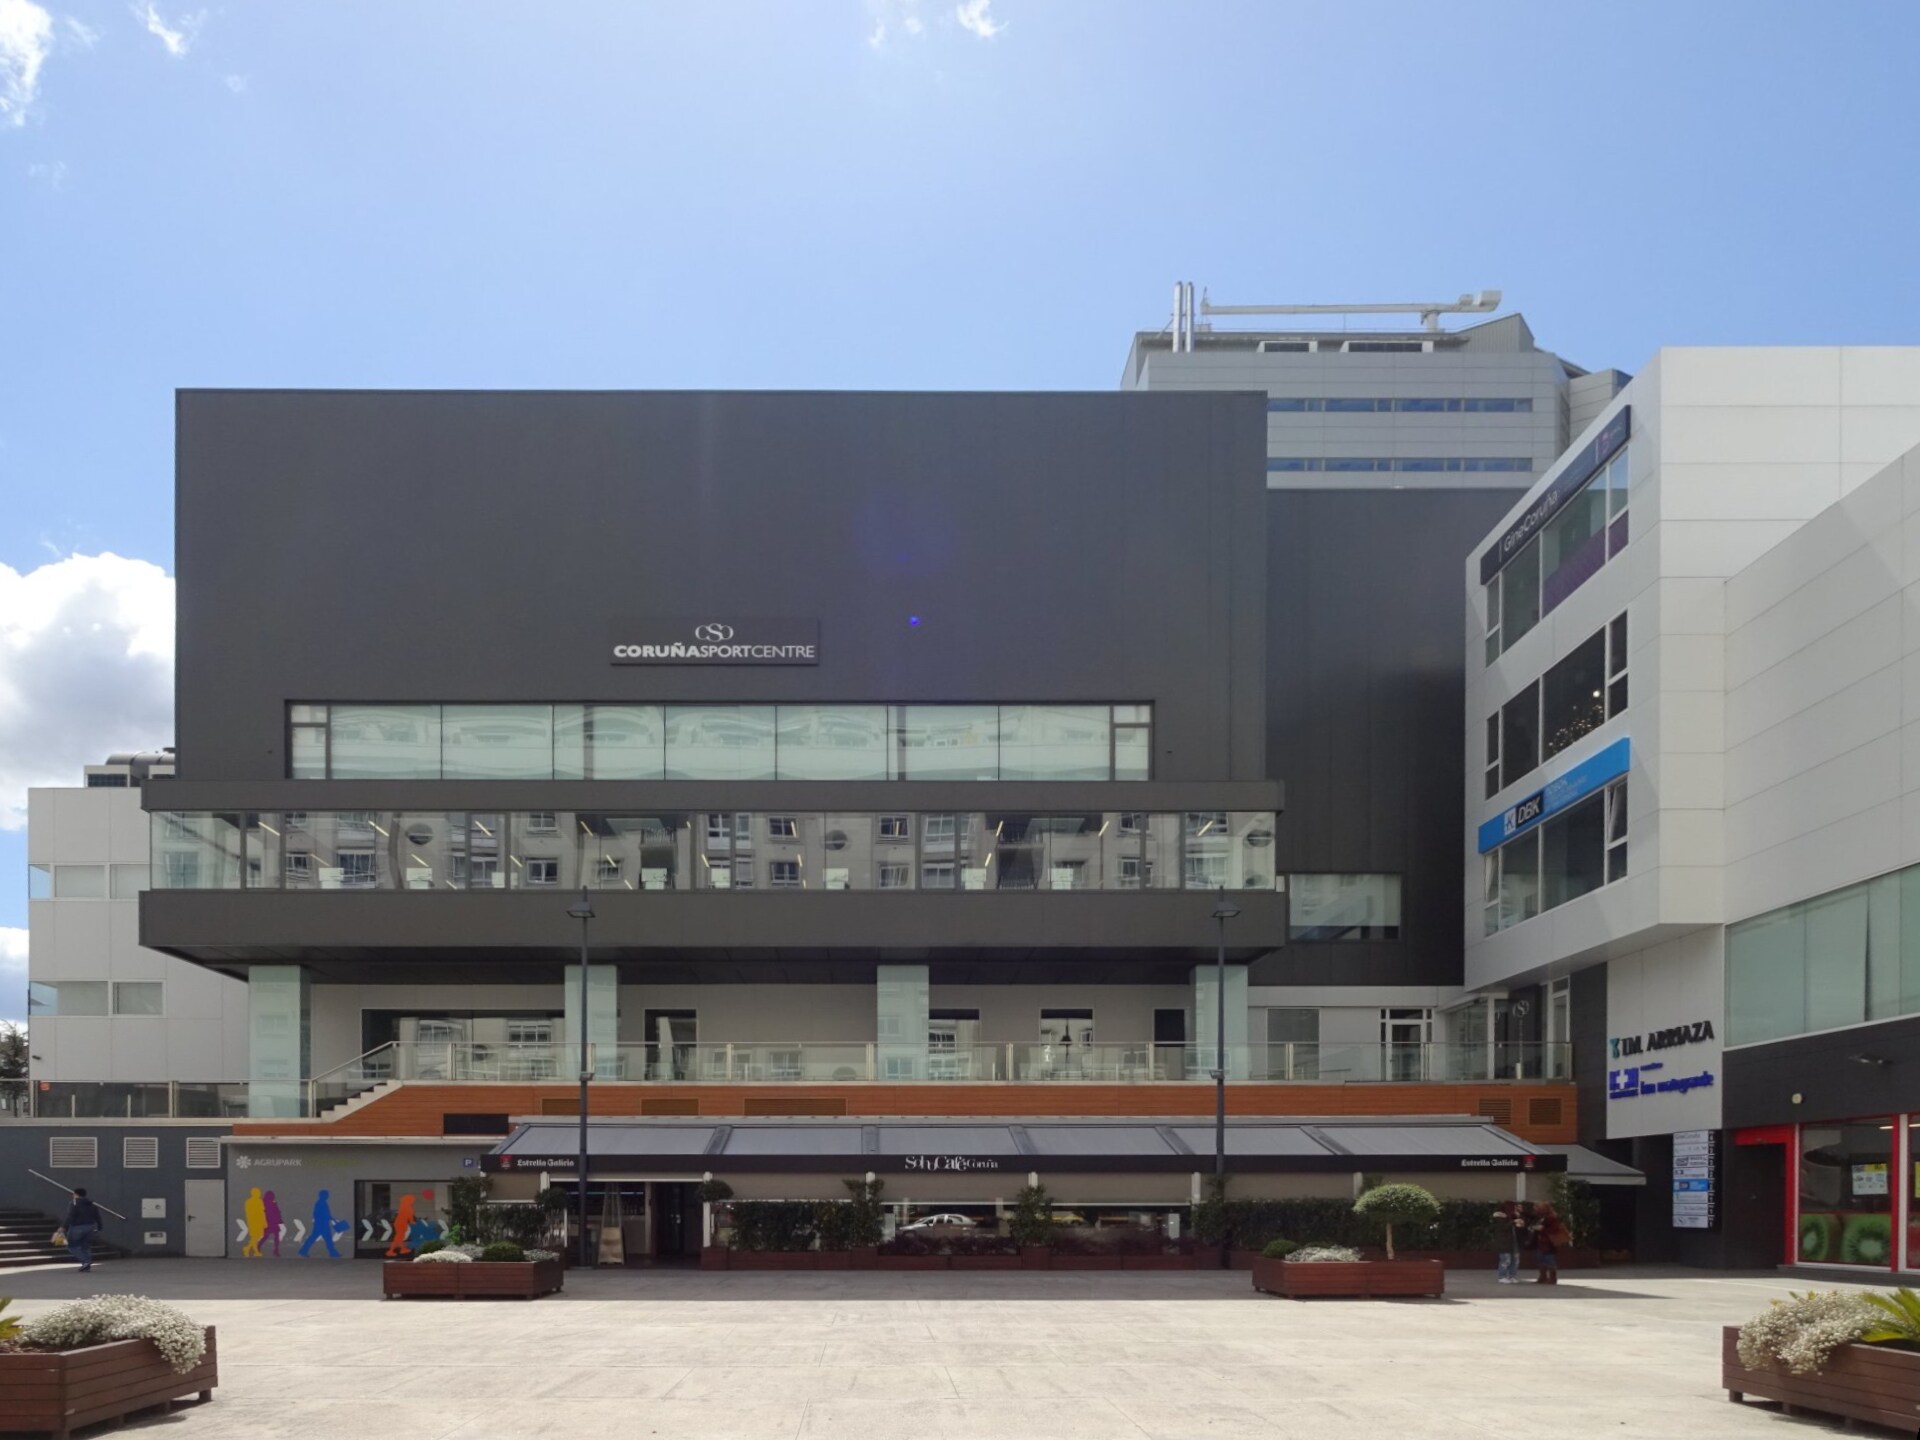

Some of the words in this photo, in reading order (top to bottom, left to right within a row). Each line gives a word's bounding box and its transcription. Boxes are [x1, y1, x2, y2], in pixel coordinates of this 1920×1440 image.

[1517, 795, 1541, 824] DBK
[253, 1158, 303, 1167] AGRUPARK
[516, 1158, 546, 1167] Estrella
[547, 1158, 574, 1167] Galicia
[1461, 1158, 1490, 1167] Estrella
[1491, 1158, 1519, 1167] Galicia
